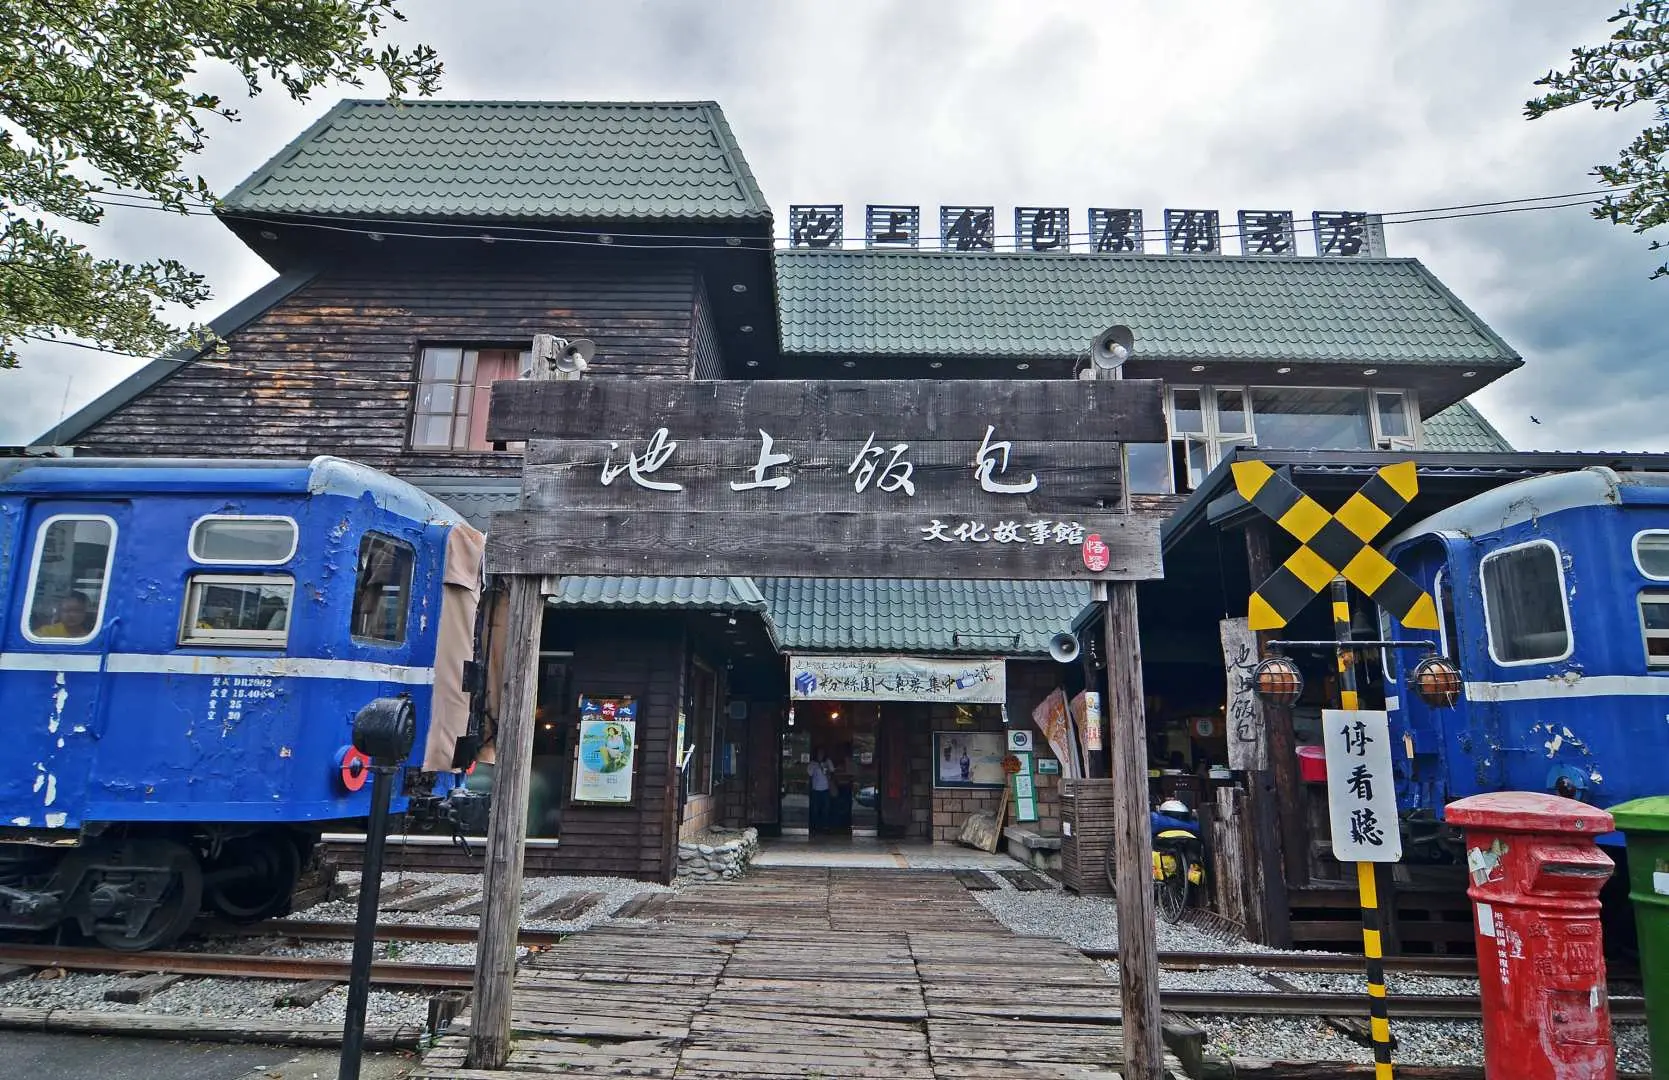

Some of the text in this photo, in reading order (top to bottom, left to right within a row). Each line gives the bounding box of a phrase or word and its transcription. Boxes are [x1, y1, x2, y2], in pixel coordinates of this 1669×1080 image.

[794, 207, 1367, 256] 池上飯包原創老店
[599, 424, 1038, 497] 池上飯包
[920, 518, 1085, 545] 文化故事館
[819, 673, 955, 695] 粉絲團人氣募集中
[1226, 644, 1258, 742] 池上飯包
[1340, 721, 1384, 846] 停看聽
